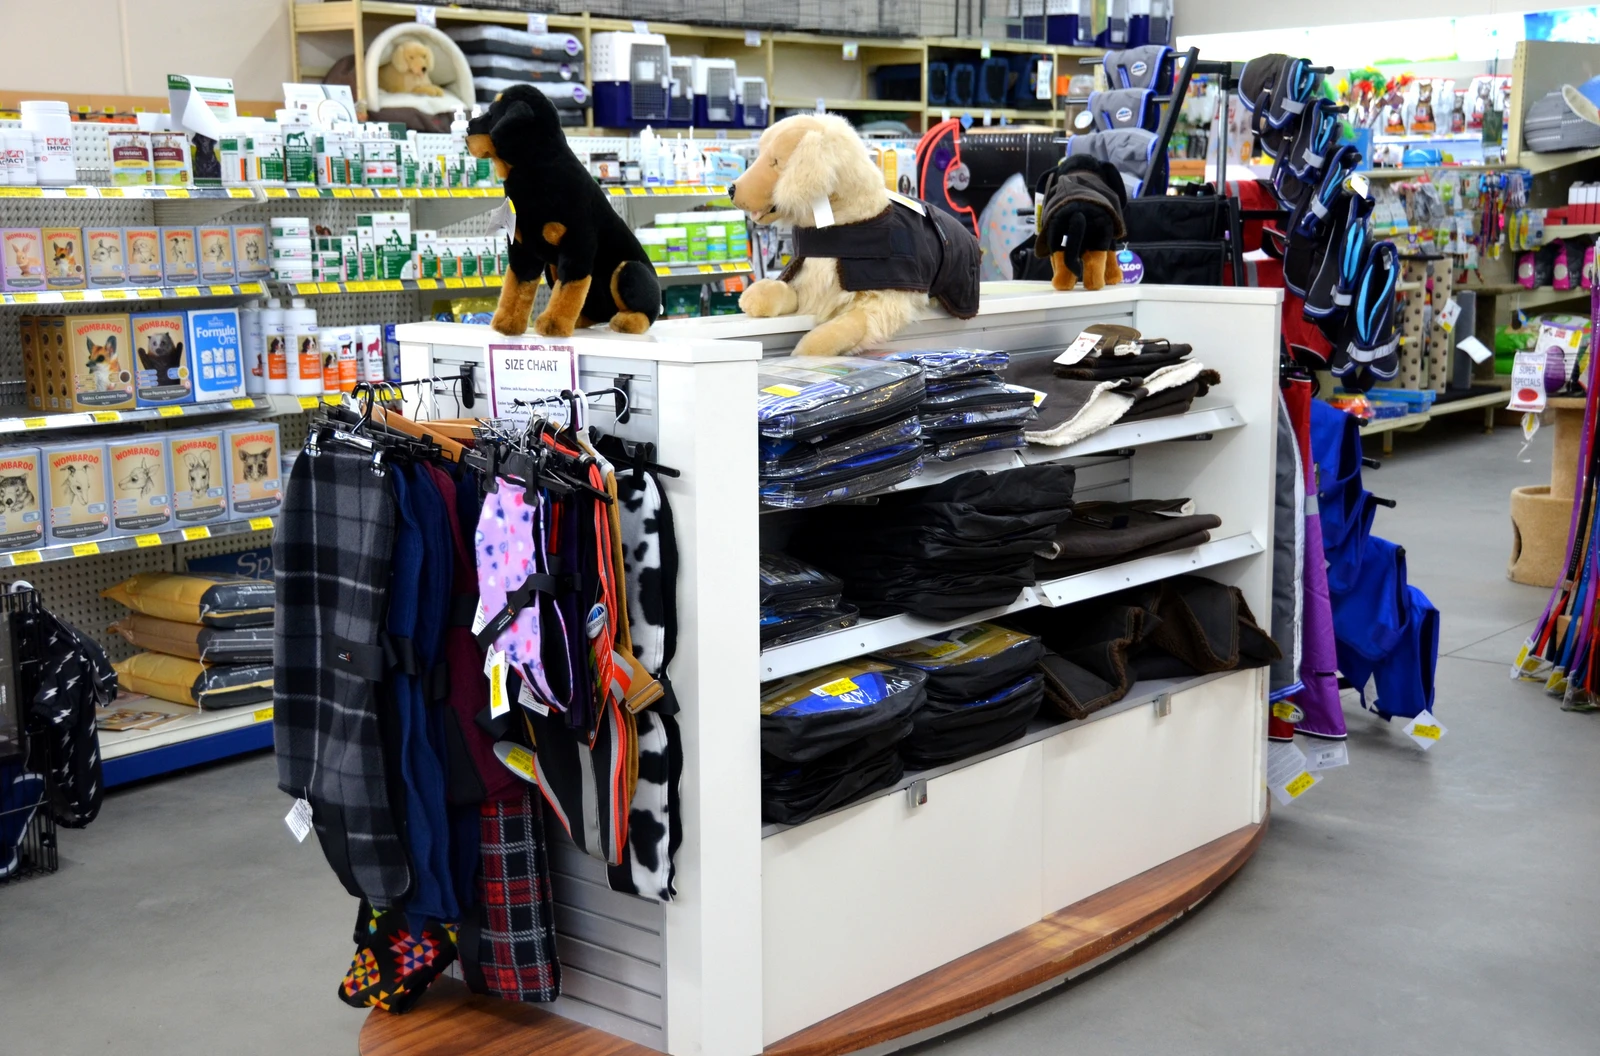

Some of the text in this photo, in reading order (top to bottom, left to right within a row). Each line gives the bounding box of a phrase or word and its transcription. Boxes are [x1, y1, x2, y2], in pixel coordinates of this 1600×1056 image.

[77, 323, 123, 336] WOMBAROO
[137, 320, 181, 333] WOMBAROO
[196, 325, 236, 338] Formula
[218, 335, 236, 345] One
[505, 359, 558, 371] SIZE CHART
[1519, 365, 1536, 374] SUPER
[1515, 378, 1541, 387] SPECIALS
[176, 440, 217, 455] WOMBAROO
[235, 434, 273, 448] WOMBAROO
[53, 453, 99, 468] WOMBAROO
[115, 447, 160, 461] WOMBAROO
